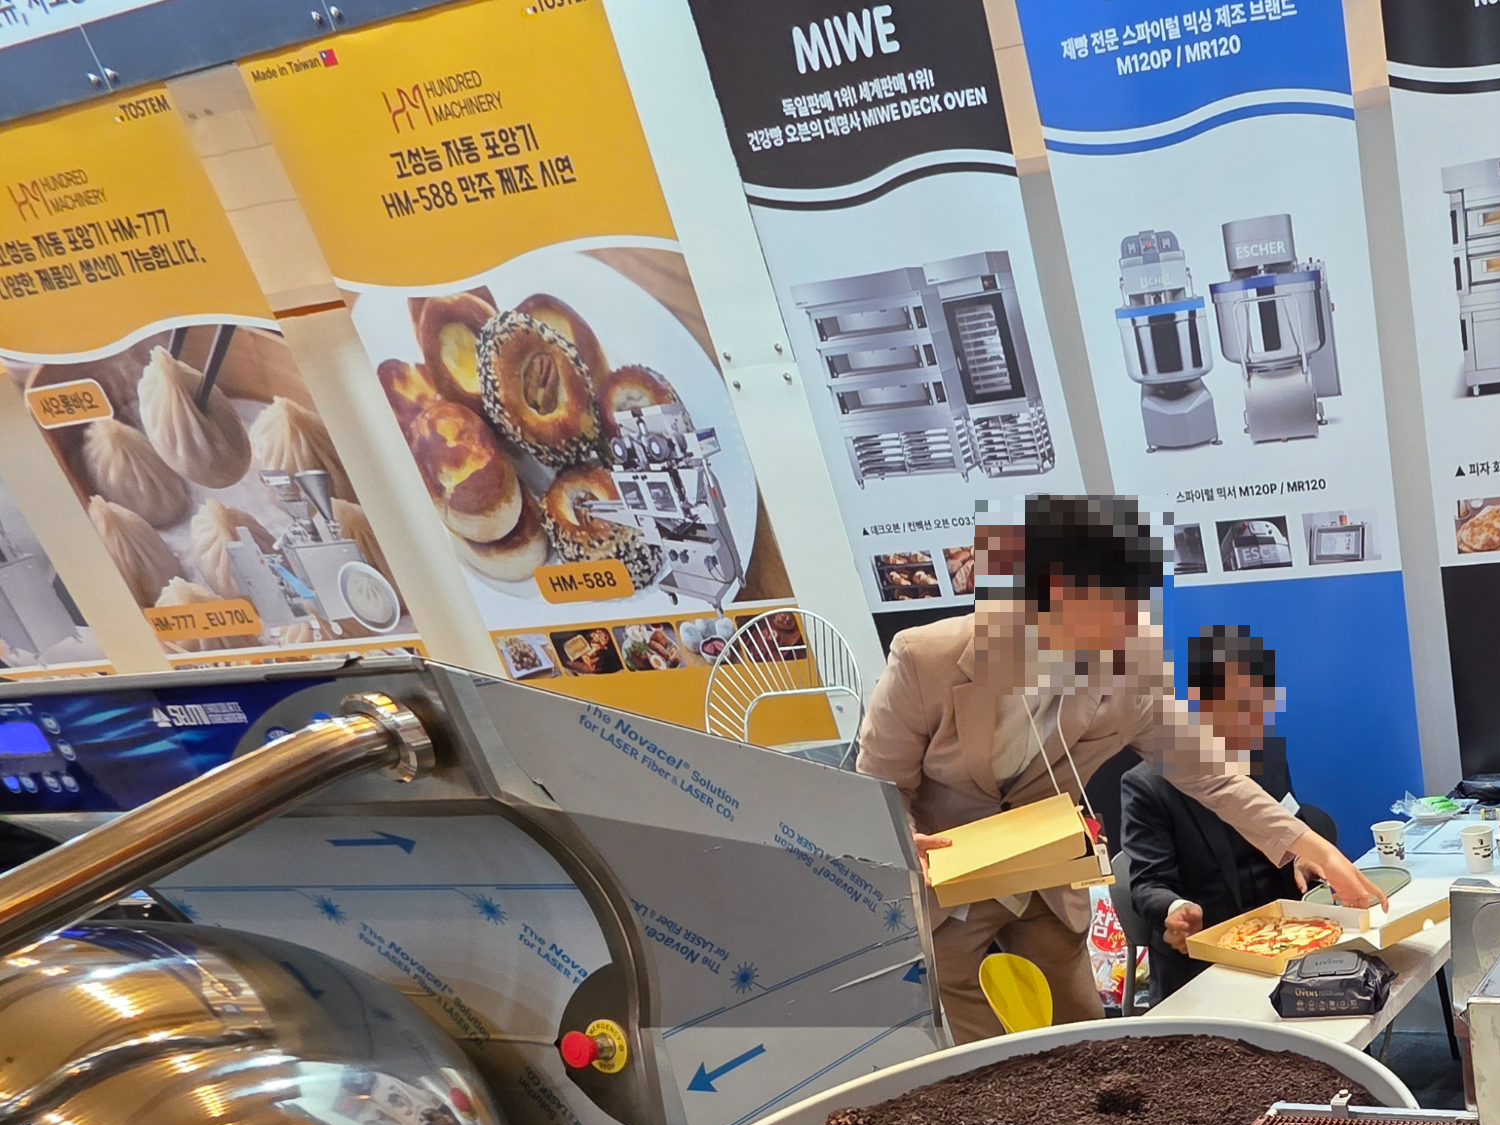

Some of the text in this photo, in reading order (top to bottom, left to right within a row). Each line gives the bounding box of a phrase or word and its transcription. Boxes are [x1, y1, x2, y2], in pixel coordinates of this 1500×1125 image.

[792, 4, 900, 74] MIWE
[1061, 34, 1089, 60] 제빵
[1090, 29, 1120, 55] 전문
[1121, 17, 1180, 47] 스파이럴
[1183, 13, 1212, 35] 믹싱
[1215, 3, 1247, 29] 제조
[1116, 48, 1172, 76] M120P
[1185, 34, 1242, 64] MR120
[251, 56, 321, 83] Made in Taiwan
[423, 70, 482, 98] HUNDRED
[781, 68, 935, 119] 독일판매 1위! 세계판매 1위!
[119, 95, 171, 121] TOSTEM
[431, 91, 503, 123] MACHINERY
[746, 87, 988, 151] 건강빵 오븐의 대명사 MIWE DECK OVEN
[389, 122, 540, 179] 고성능 자동 포앙기
[38, 168, 88, 191] HUNDRED
[381, 155, 577, 219] HM-588 만쥬 제조 시연
[48, 187, 107, 213] MACHINERY
[32, 208, 171, 258] 자동 포앙기 HM-777
[1235, 241, 1287, 260] ESCHER
[34, 238, 206, 292] 제품의 생산이 가능합니다.
[1468, 461, 1490, 476] 피자
[1176, 488, 1215, 503] 스파이럴
[1216, 486, 1237, 500] 믹서
[1239, 483, 1278, 497] M120P
[1286, 478, 1326, 493] MR120
[870, 522, 901, 535] 데크오븐
[908, 520, 932, 532] 컨벡션
[933, 518, 950, 529] 오븐
[549, 571, 617, 593] HM-588
[151, 614, 196, 632] HM-777
[225, 608, 253, 625] 70L
[167, 705, 209, 727] SELMI
[579, 714, 598, 733] for
[600, 727, 638, 760] LASER
[641, 754, 671, 780] Fiber
[679, 779, 714, 808] LASER
[690, 770, 739, 809] Solution
[797, 836, 825, 859] LASER
[774, 834, 878, 913] The Solution
[848, 870, 876, 896] LASER
[873, 888, 884, 901] for
[521, 923, 546, 945] The
[656, 913, 729, 961] for LASER Fiber
[518, 933, 571, 978] for LASER
[701, 956, 721, 974] The
[359, 933, 469, 1033] for LASER Fiber LASER
[360, 922, 492, 1040] The Solution
[1294, 989, 1318, 997] LIVENS
[539, 1086, 568, 1115] LASER
